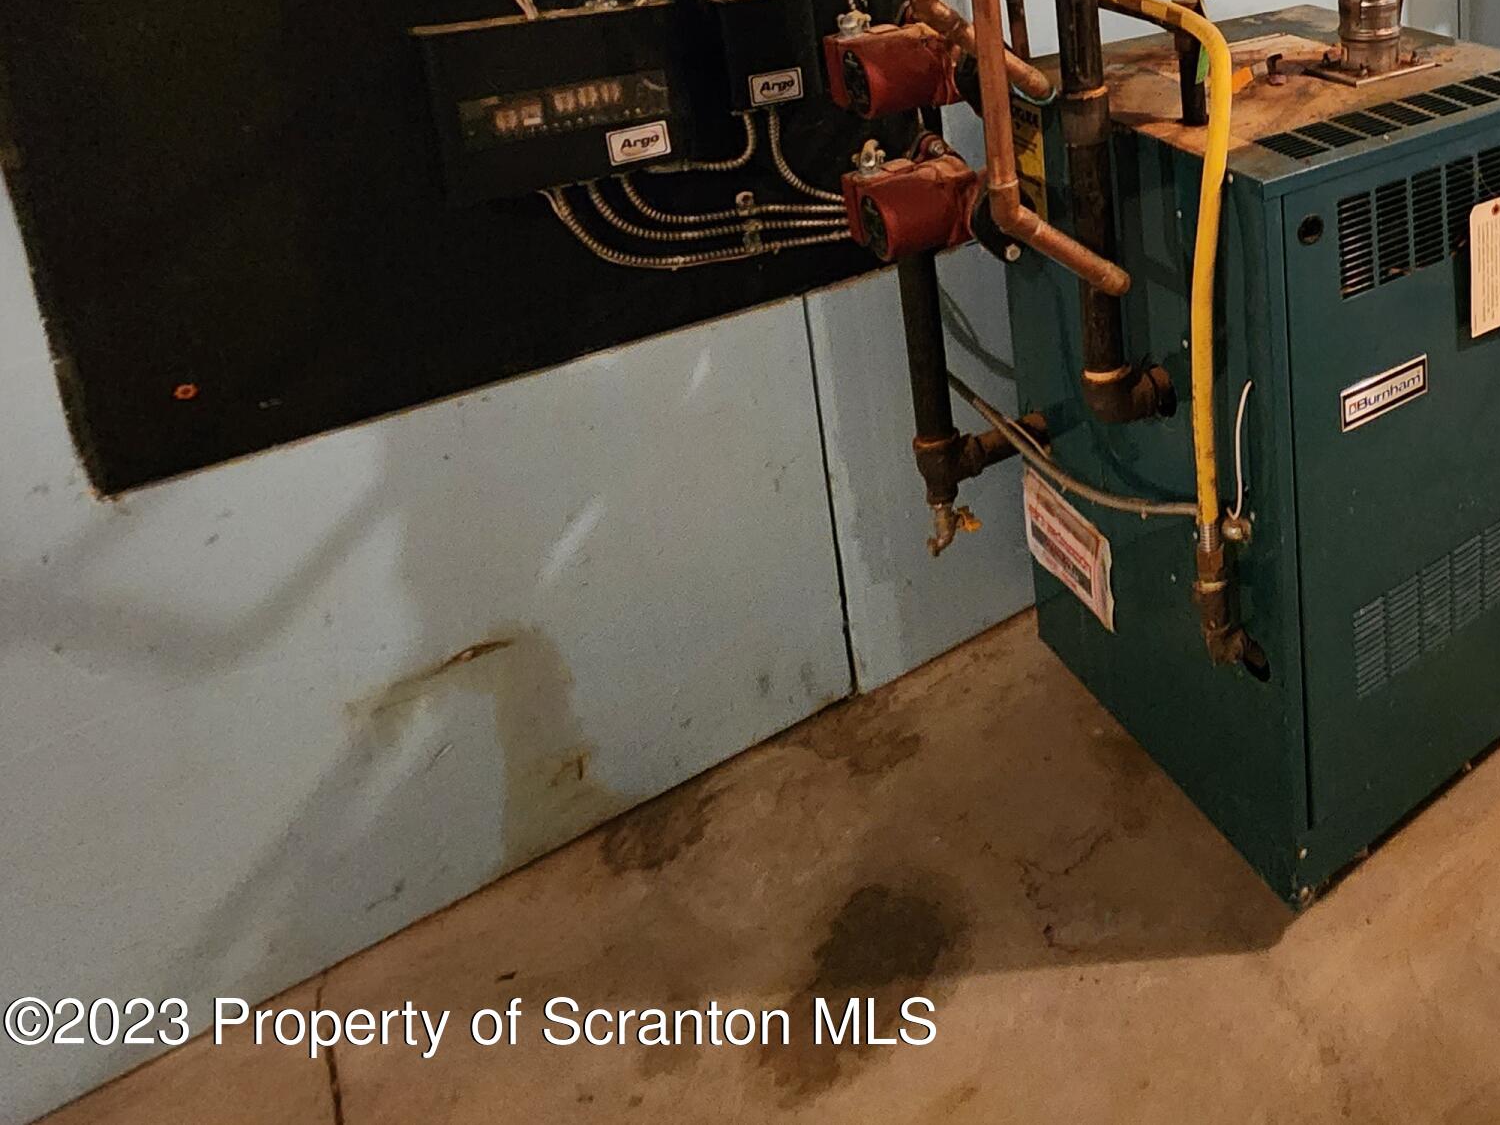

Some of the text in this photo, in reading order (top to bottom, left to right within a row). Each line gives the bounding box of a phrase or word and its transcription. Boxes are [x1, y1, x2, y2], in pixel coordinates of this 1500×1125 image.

[761, 79, 795, 92] Argo
[620, 134, 660, 149] Argo
[1357, 374, 1421, 412] Burnham
